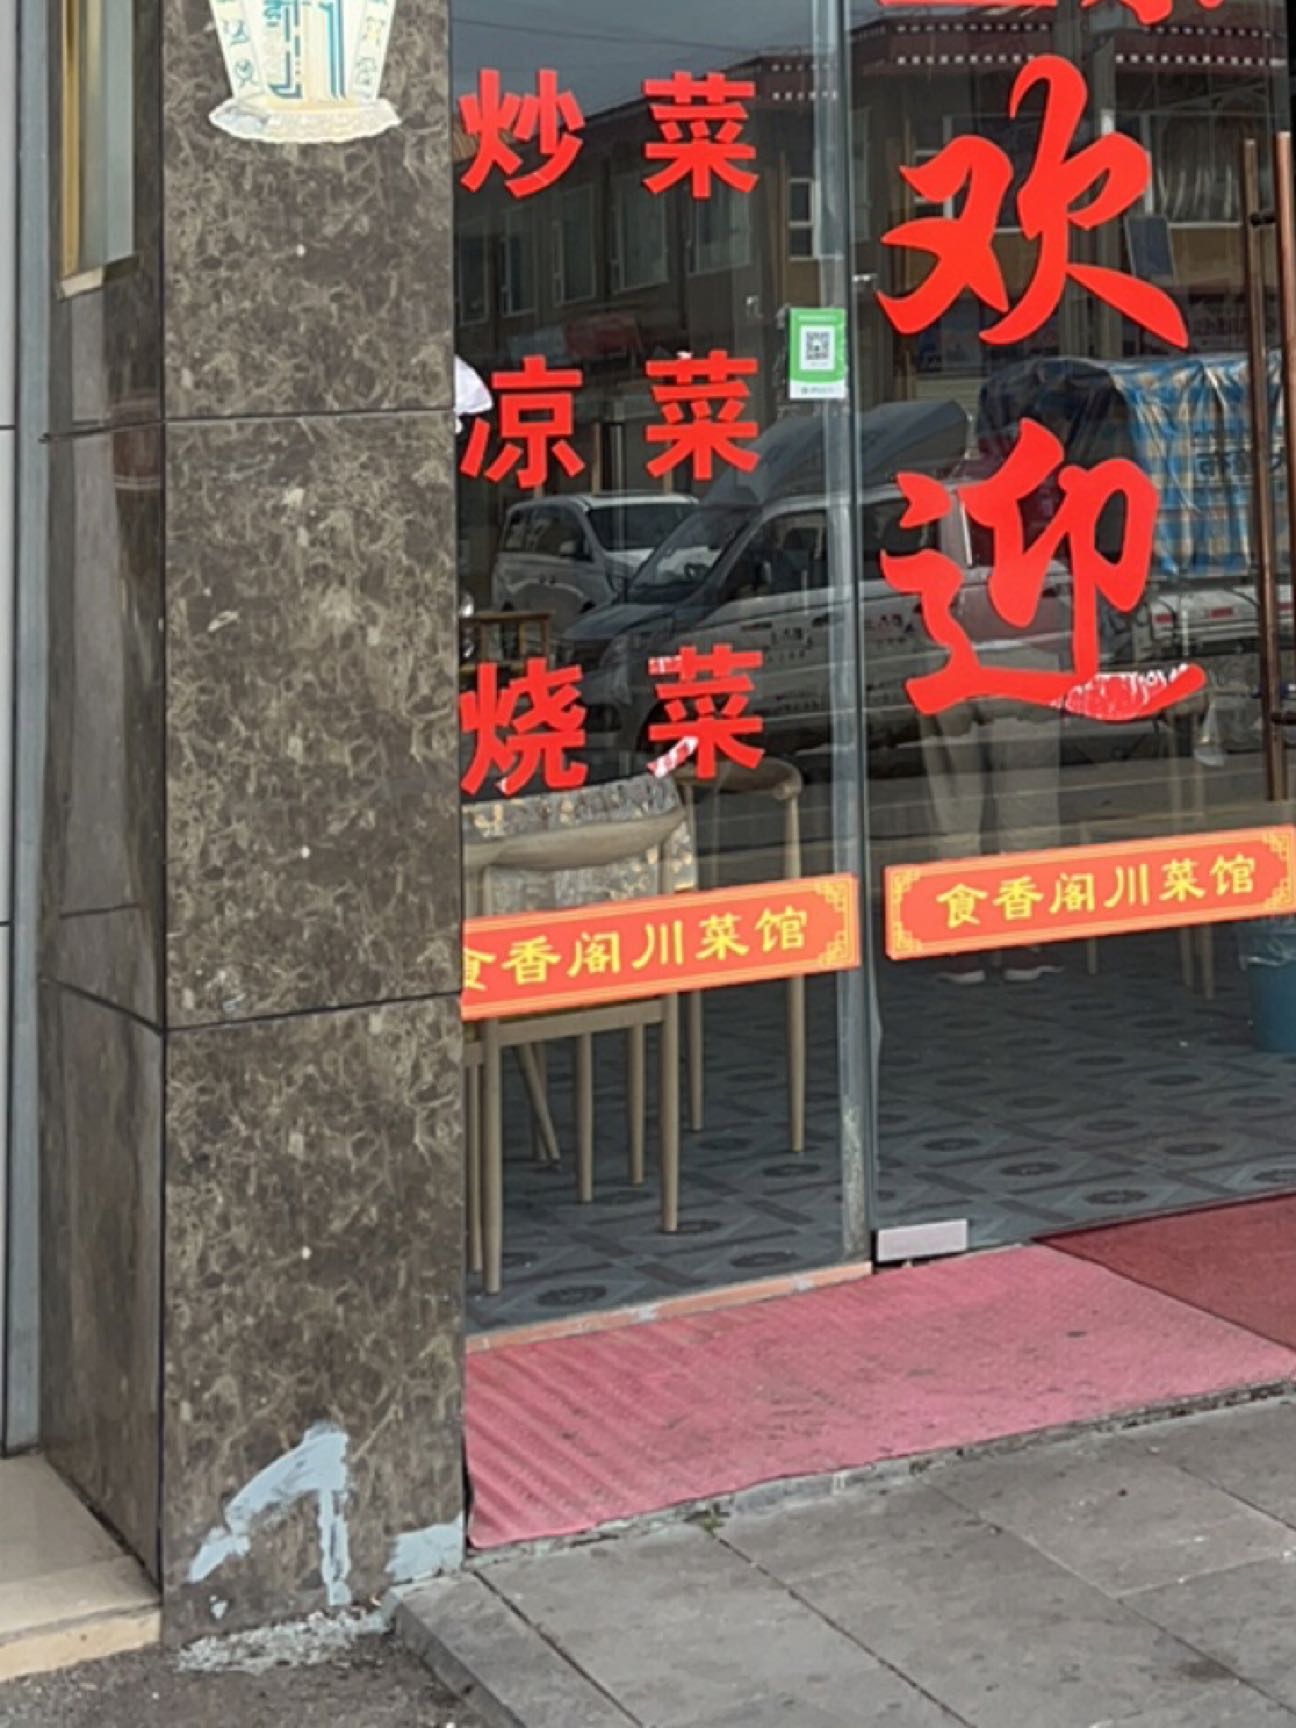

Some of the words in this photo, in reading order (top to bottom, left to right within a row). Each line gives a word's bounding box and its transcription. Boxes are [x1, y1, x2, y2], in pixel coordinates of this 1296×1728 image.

[458, 68, 760, 200] 炒菜
[460, 349, 760, 490] 凉菜
[876, 55, 1208, 721] 欢迎
[458, 644, 763, 797] 烧菜
[936, 853, 1256, 930] 食香阁川菜馆
